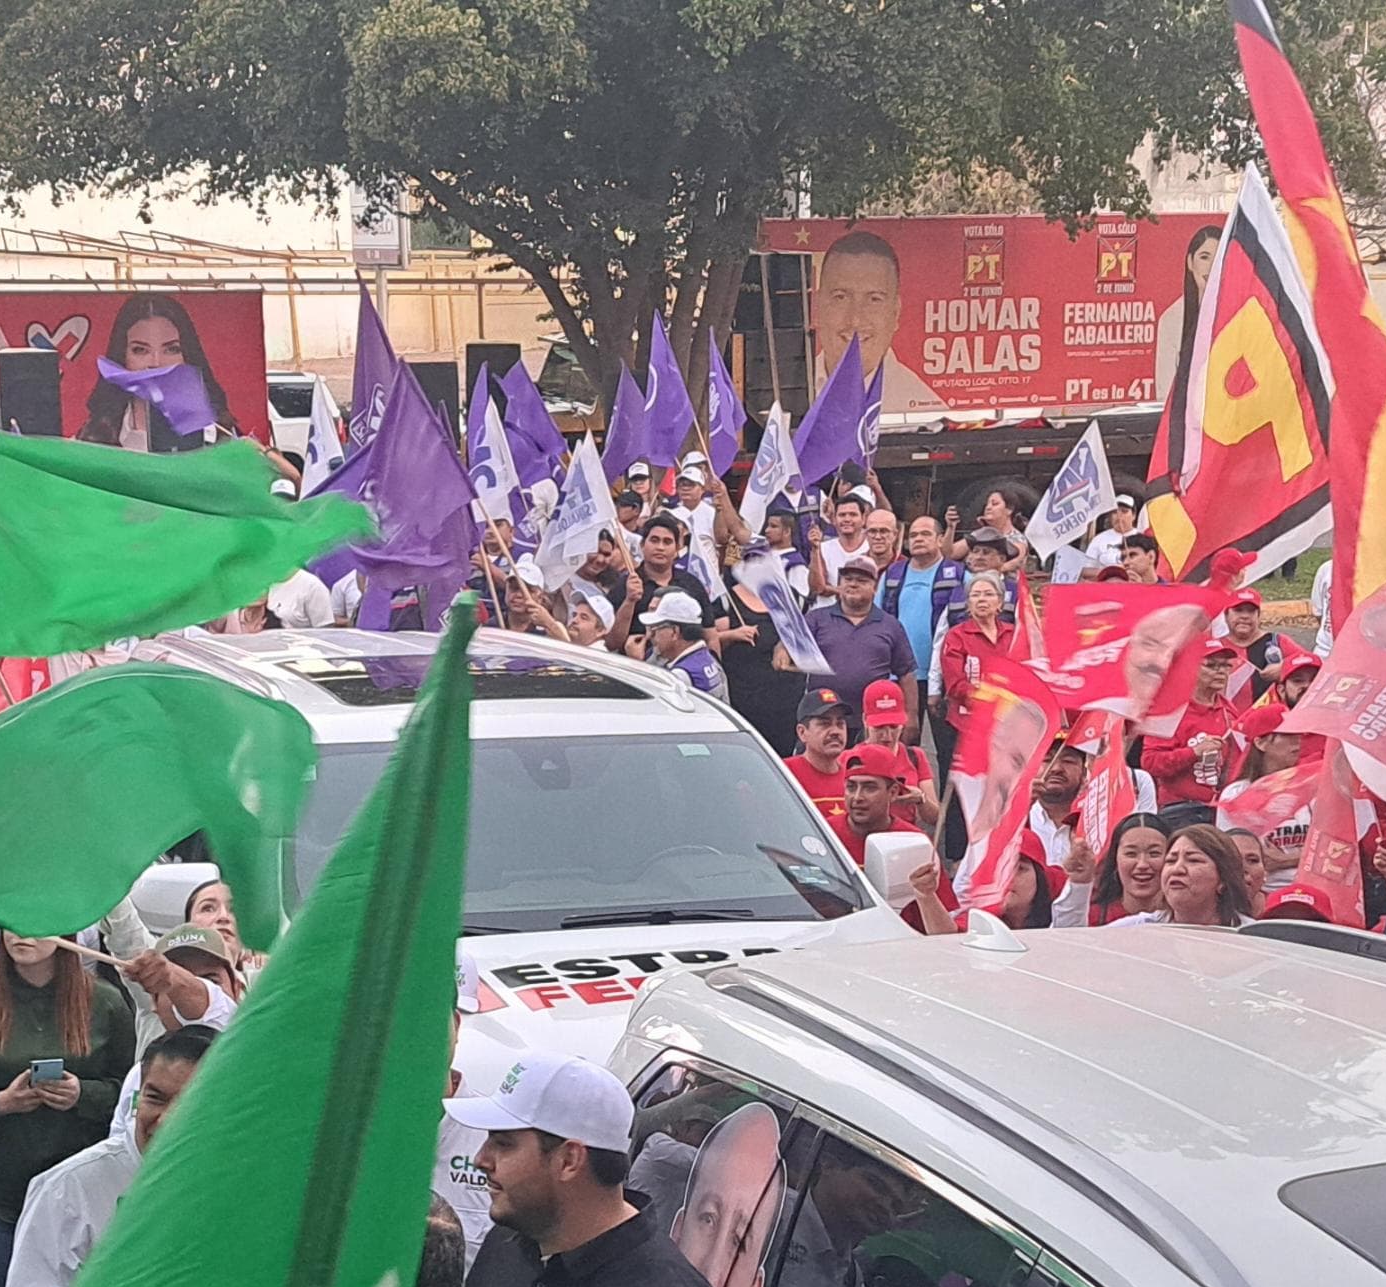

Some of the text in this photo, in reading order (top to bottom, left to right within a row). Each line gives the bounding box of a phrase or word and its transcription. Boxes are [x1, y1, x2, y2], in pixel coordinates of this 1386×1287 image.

[967, 254, 1000, 281] PT
[1101, 252, 1133, 277] PT
[924, 297, 1041, 333] HOMAR
[1064, 300, 1156, 324] FERNANDA
[1064, 323, 1155, 346] CABALLERO
[923, 334, 1042, 375] SALAS
[971, 376, 997, 387] LOCAL
[1066, 378, 1092, 401] PT
[1092, 387, 1108, 400] es
[1127, 378, 1154, 400] 4T
